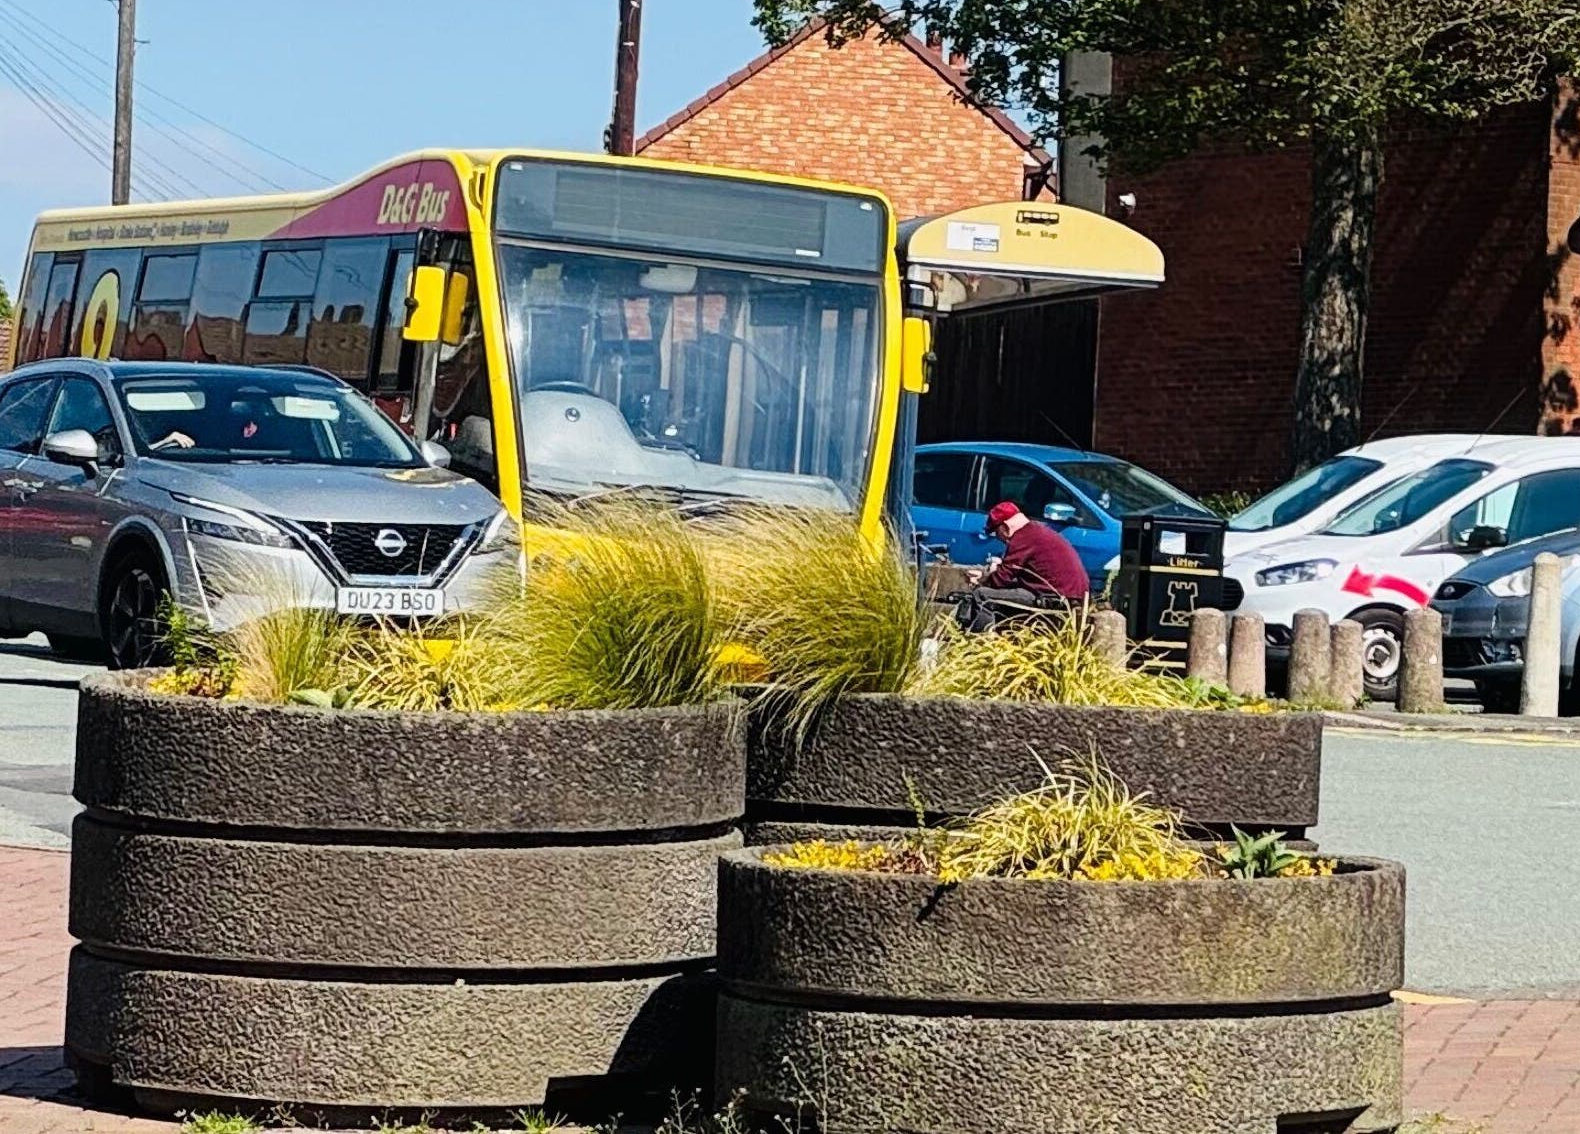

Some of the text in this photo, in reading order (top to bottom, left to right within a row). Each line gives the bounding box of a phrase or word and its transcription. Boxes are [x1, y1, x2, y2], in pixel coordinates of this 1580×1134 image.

[377, 182, 450, 224] D&G Bus
[1016, 228, 1058, 239] Bus Stop
[1169, 556, 1201, 568] Litter
[348, 591, 395, 610] DU23
